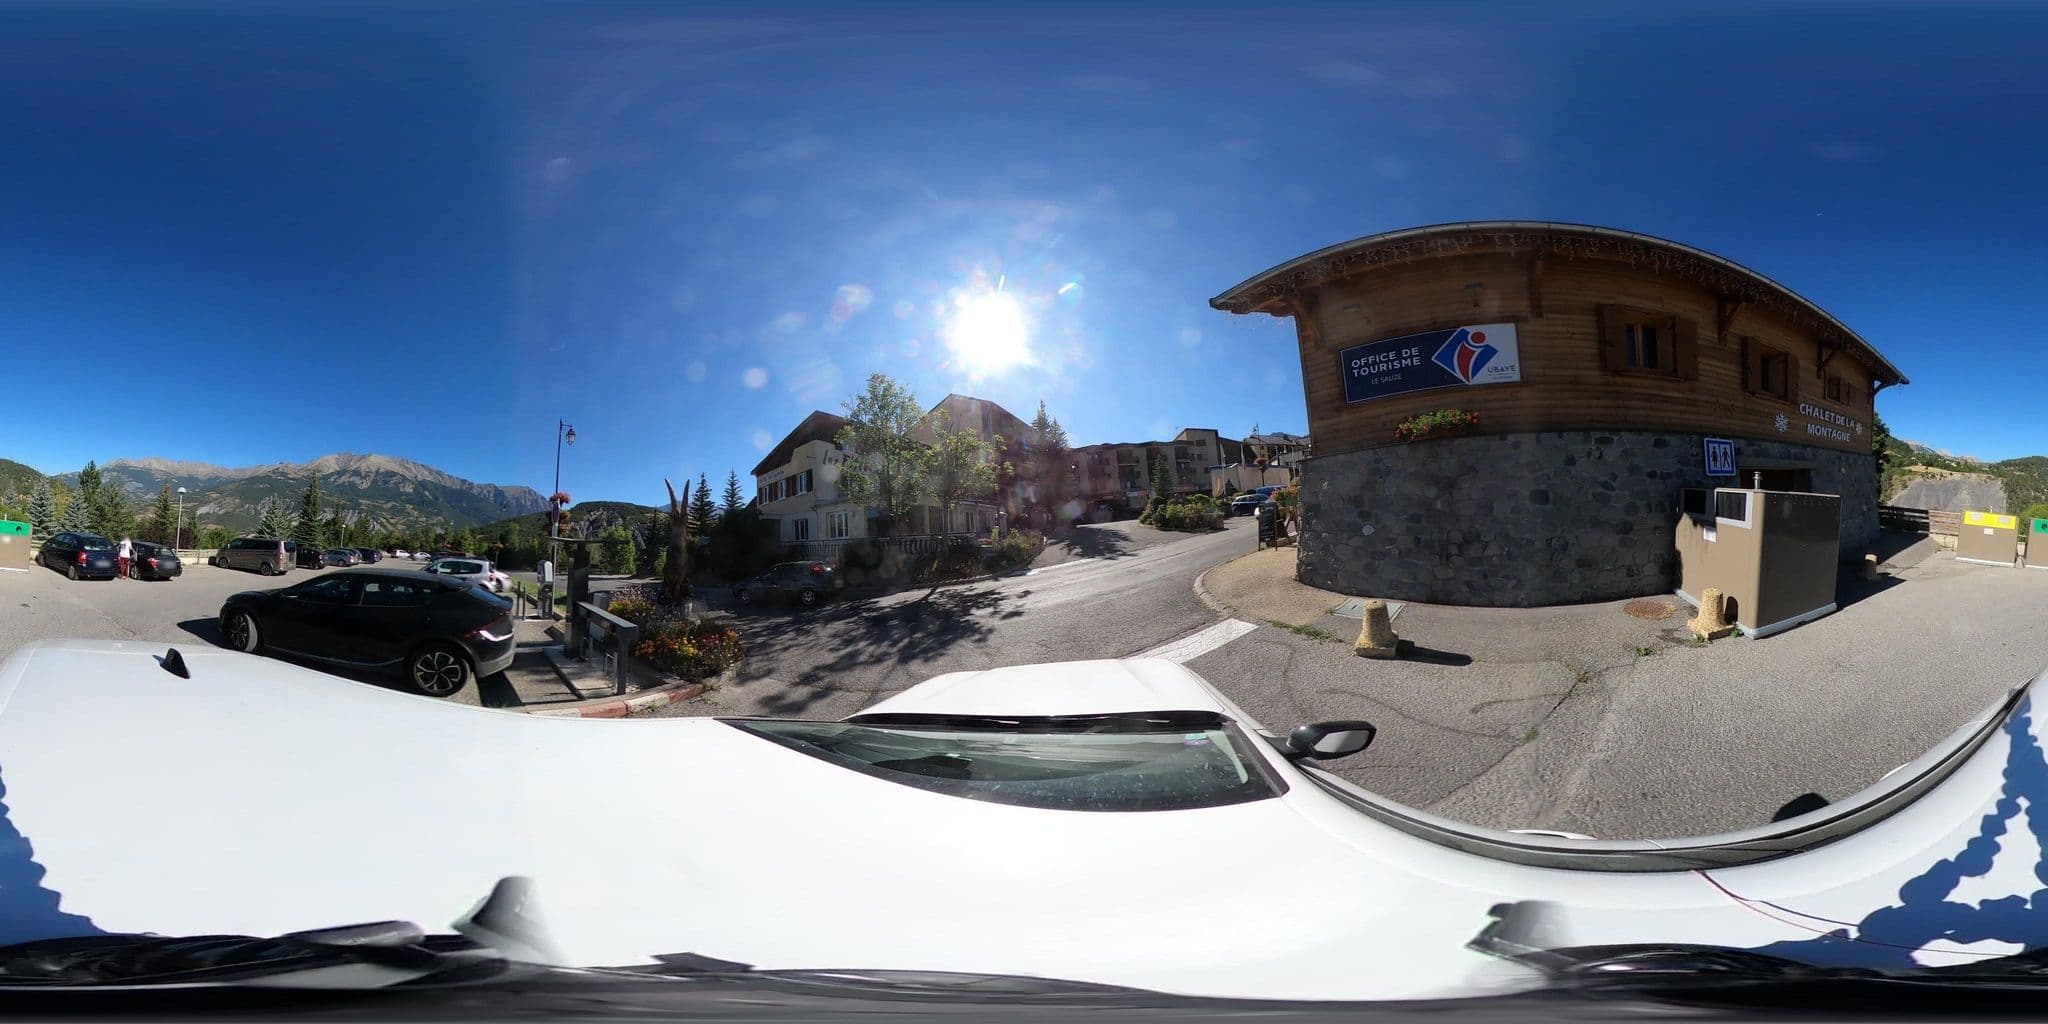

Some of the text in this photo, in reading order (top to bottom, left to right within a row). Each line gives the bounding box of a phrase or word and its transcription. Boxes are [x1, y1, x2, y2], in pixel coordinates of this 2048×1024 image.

[1351, 347, 1420, 368] OFFICE DE
[1351, 357, 1422, 377] TOURISME
[1371, 377, 1380, 385] LE
[1799, 403, 1855, 429] CHALET DE LA
[1807, 423, 1851, 442] MONTAGNE
